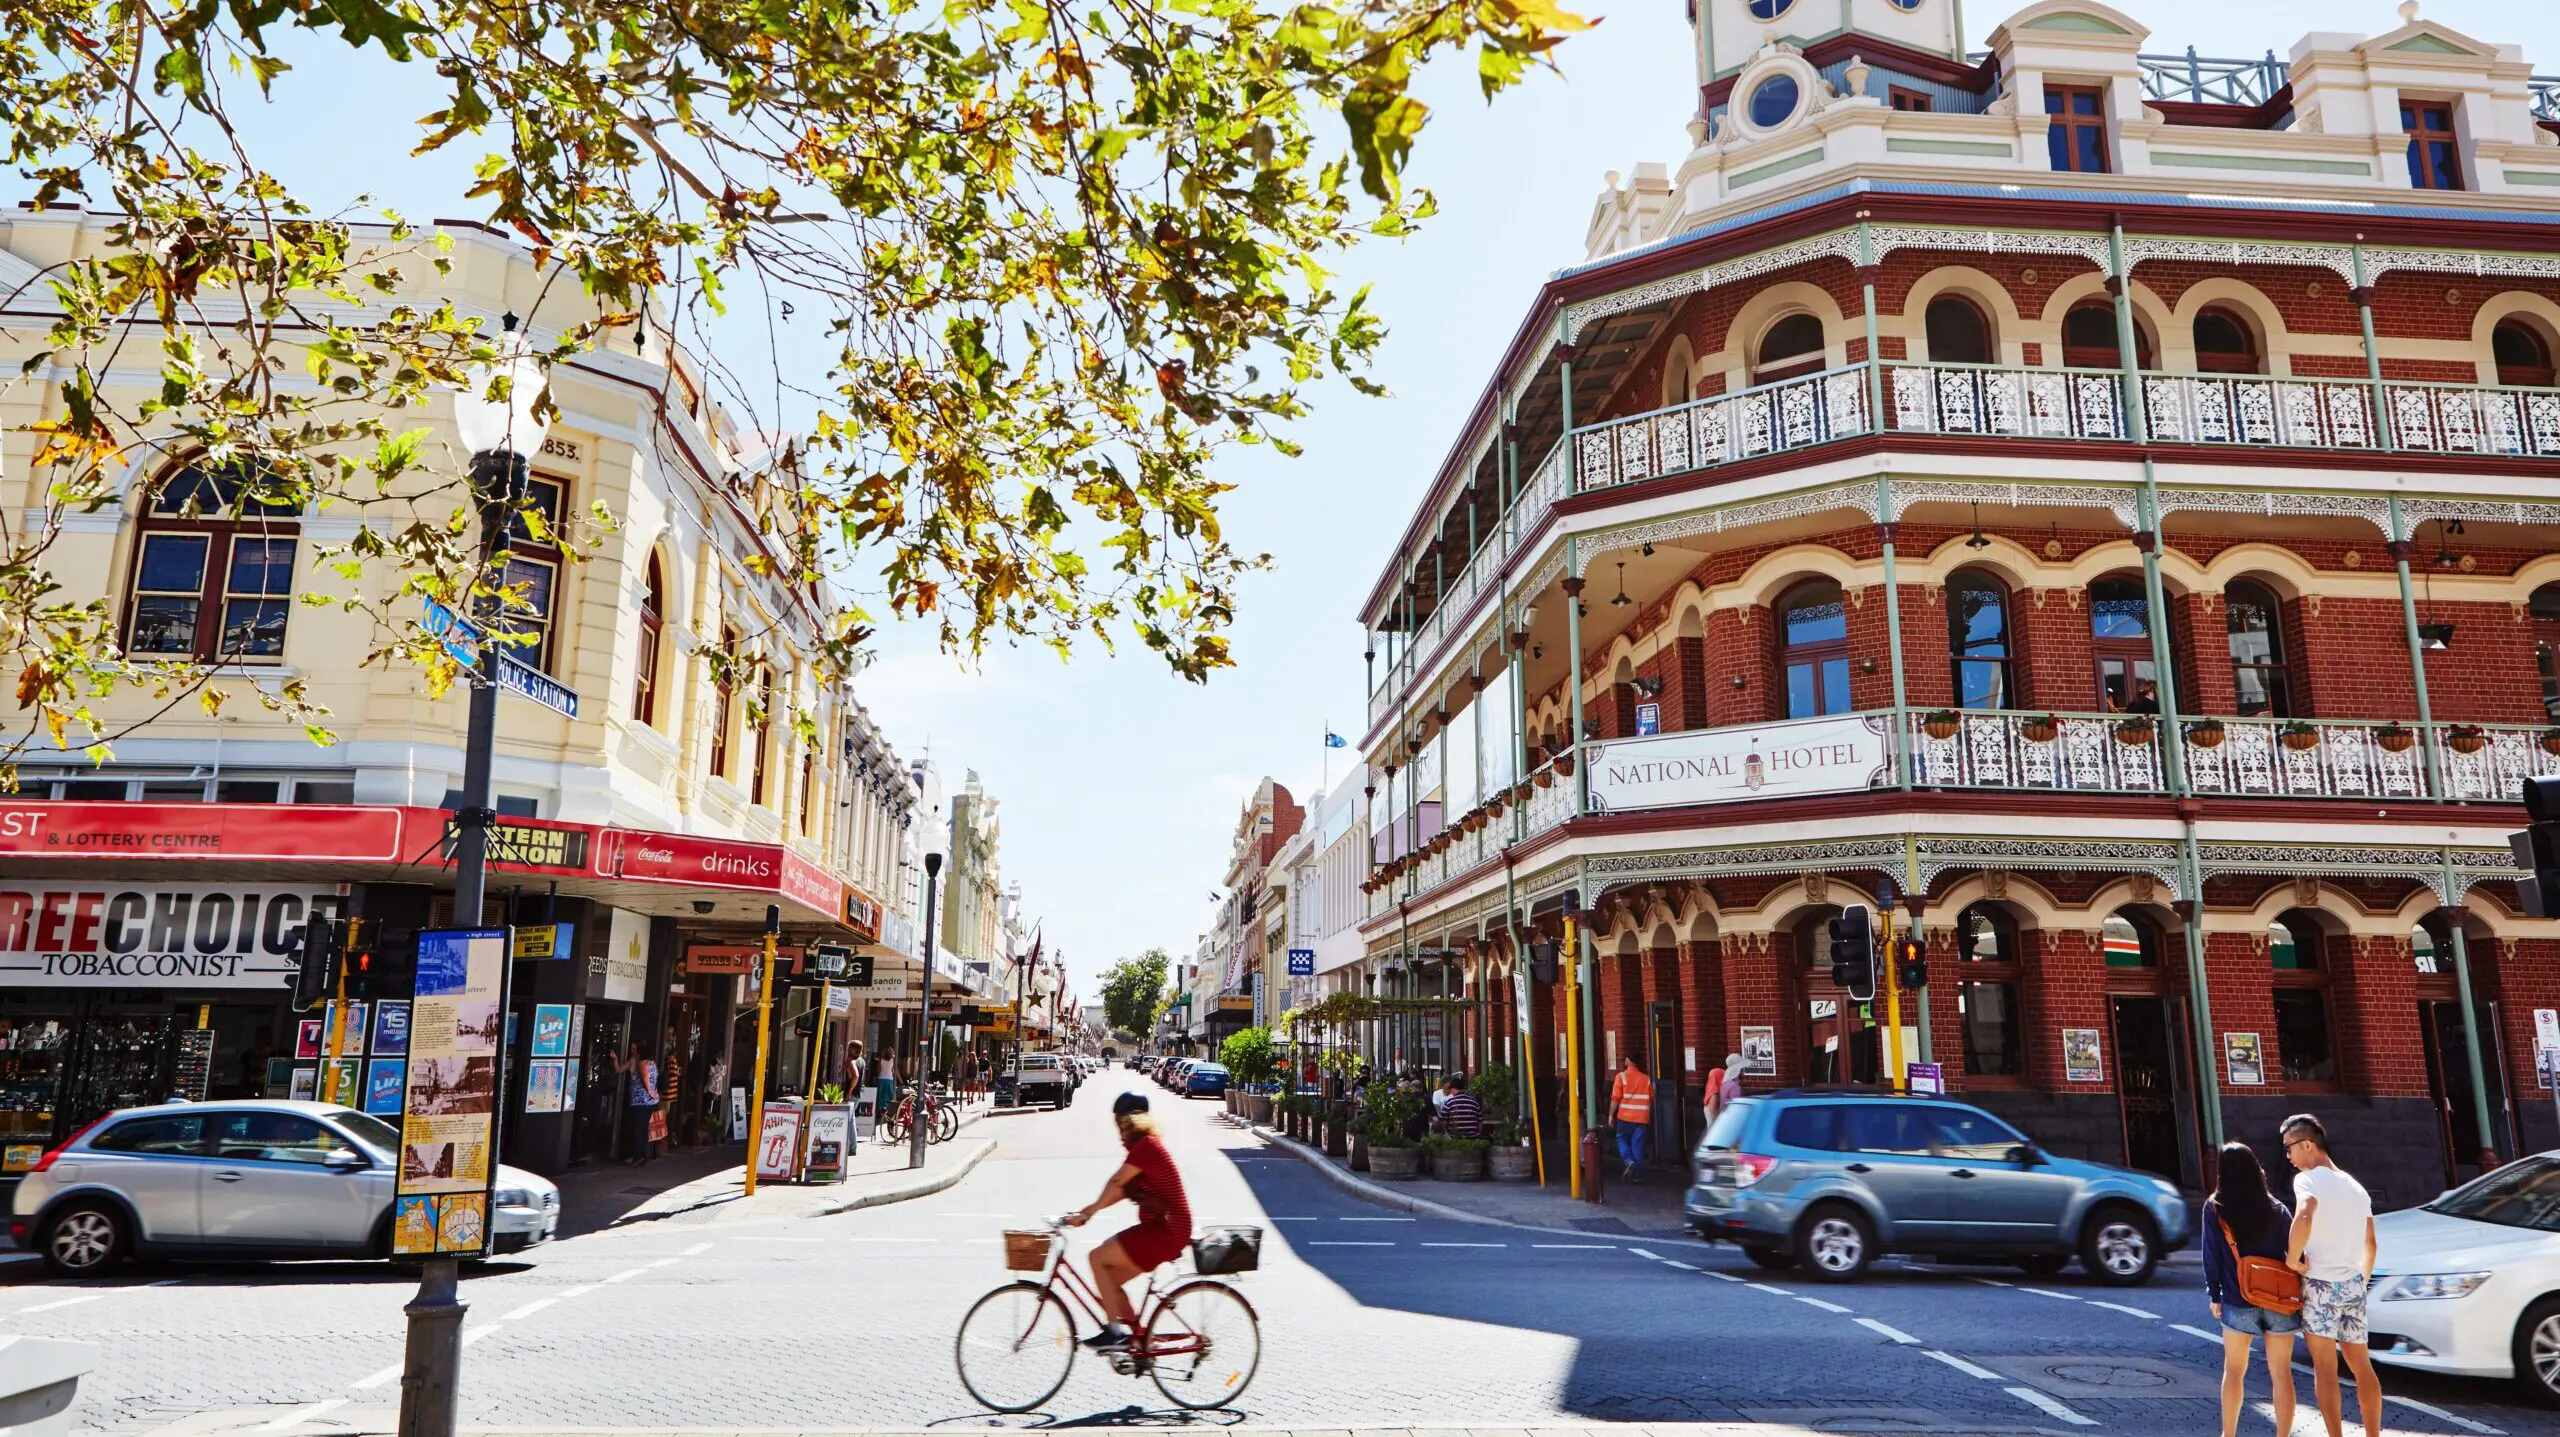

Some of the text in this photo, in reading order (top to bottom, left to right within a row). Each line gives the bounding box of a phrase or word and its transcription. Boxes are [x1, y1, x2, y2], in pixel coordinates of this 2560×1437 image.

[531, 676, 568, 712] STATION
[1608, 743, 1863, 787] NATIONAL HOTEL
[0, 811, 47, 837] ST
[48, 832, 221, 848] & LOTTERY CENTRE
[702, 851, 770, 877] drinks
[42, 953, 243, 978] TOBACCONIST
[609, 959, 647, 981] TOBACCONIST
[819, 955, 830, 970] ONE
